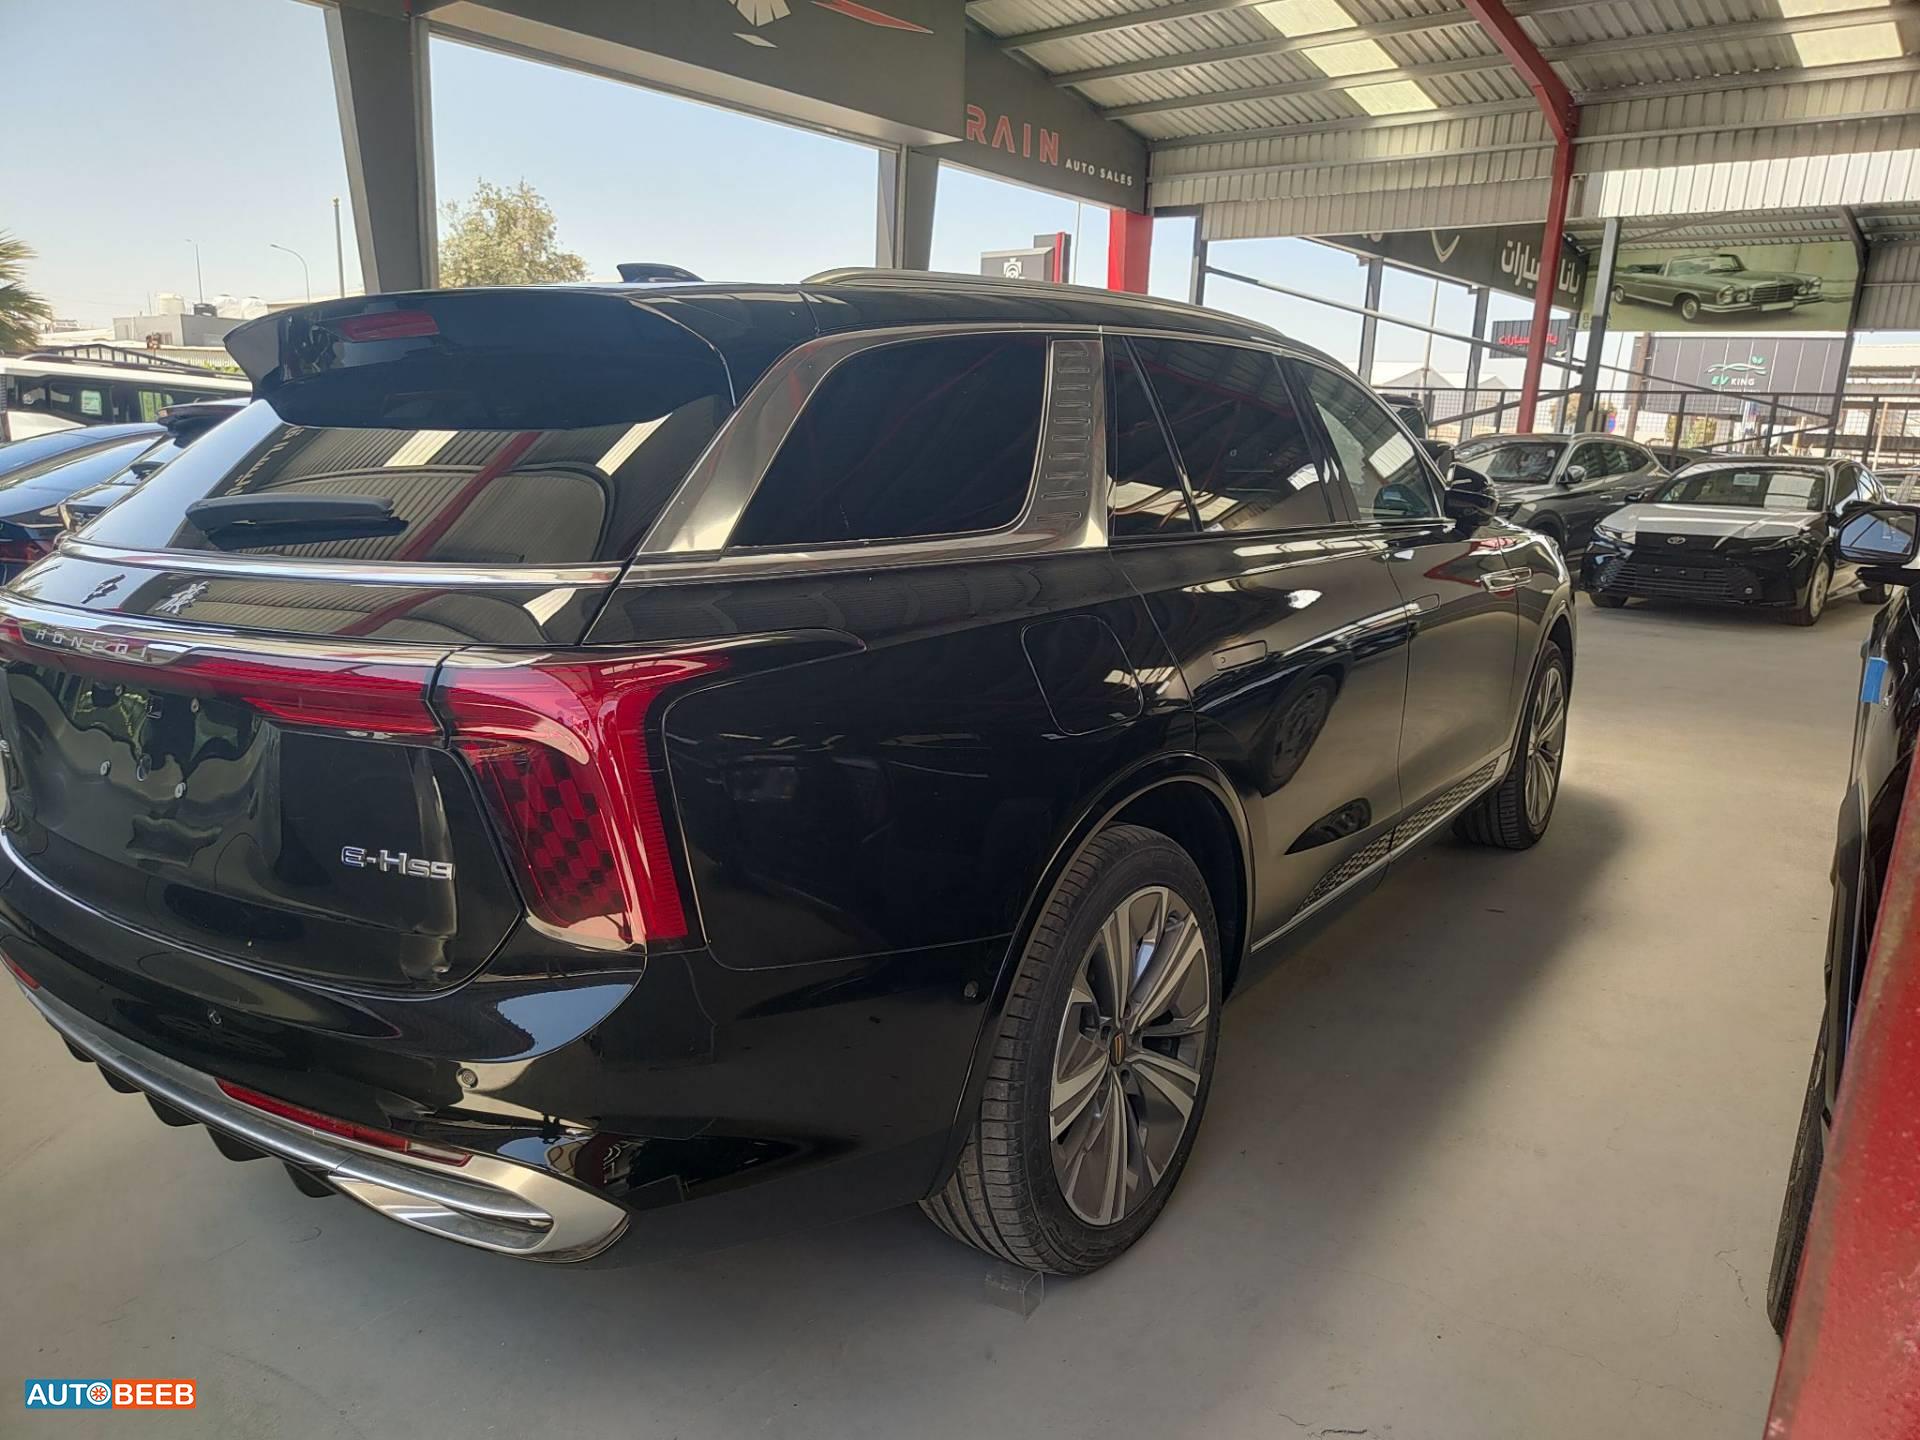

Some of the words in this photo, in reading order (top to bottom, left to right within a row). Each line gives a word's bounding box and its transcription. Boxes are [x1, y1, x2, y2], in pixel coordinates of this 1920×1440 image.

[1065, 158, 1095, 176] AUTO
[1100, 168, 1133, 187] SALES
[1711, 376, 1730, 385] EV
[1731, 378, 1755, 386] KING
